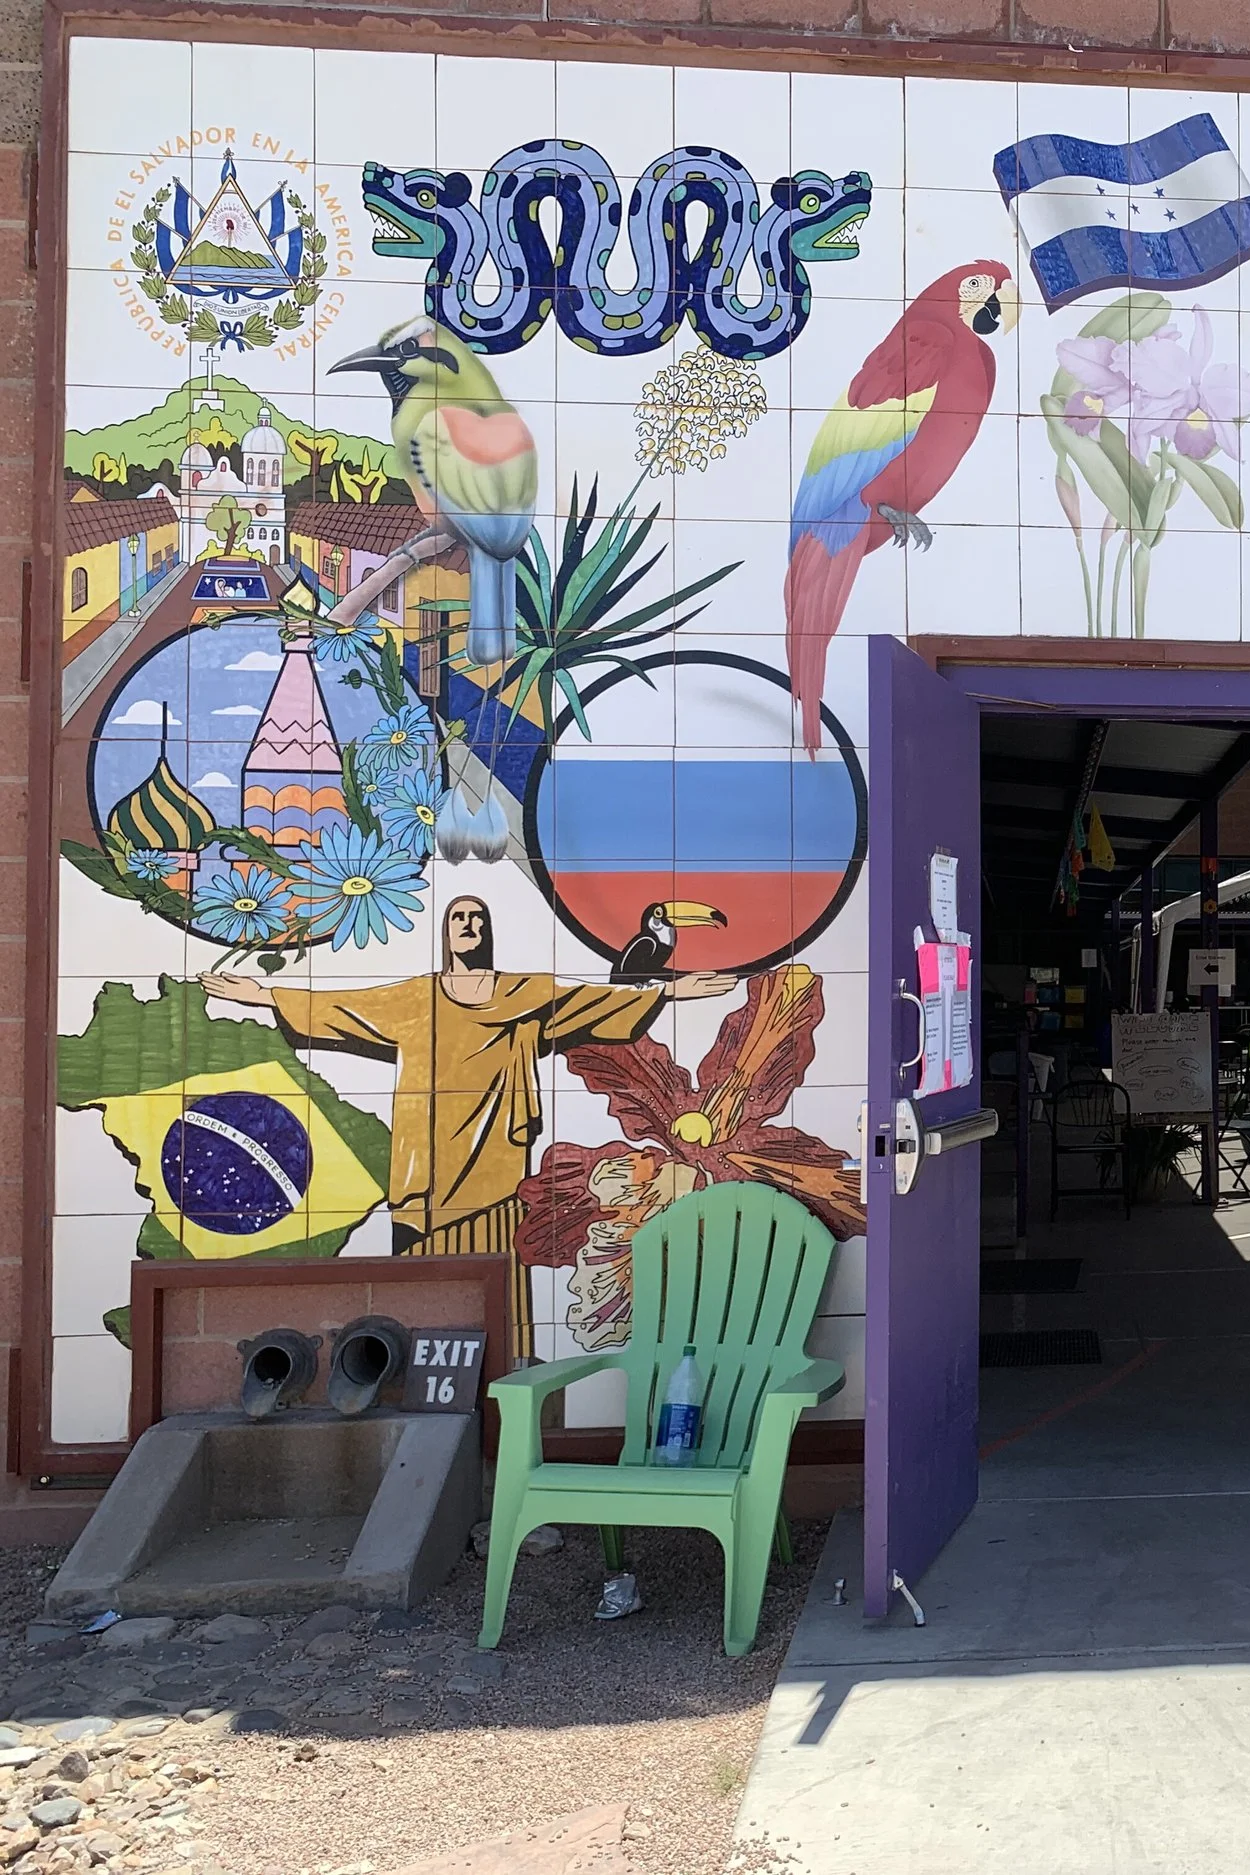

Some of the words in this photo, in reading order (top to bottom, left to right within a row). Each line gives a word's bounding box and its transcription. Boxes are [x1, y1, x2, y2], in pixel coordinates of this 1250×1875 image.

[129, 126, 236, 185] SALVADOR
[251, 132, 281, 155] EN
[283, 148, 310, 174] LA
[114, 189, 136, 210] EL
[107, 217, 124, 242] DE
[315, 182, 354, 278] AMERICA
[273, 291, 345, 362] CENTRAL
[186, 1113, 228, 1134] ORDEM
[242, 1137, 293, 1191] PROGRESSO
[413, 1339, 480, 1367] EXIT
[426, 1376, 455, 1404] 16
